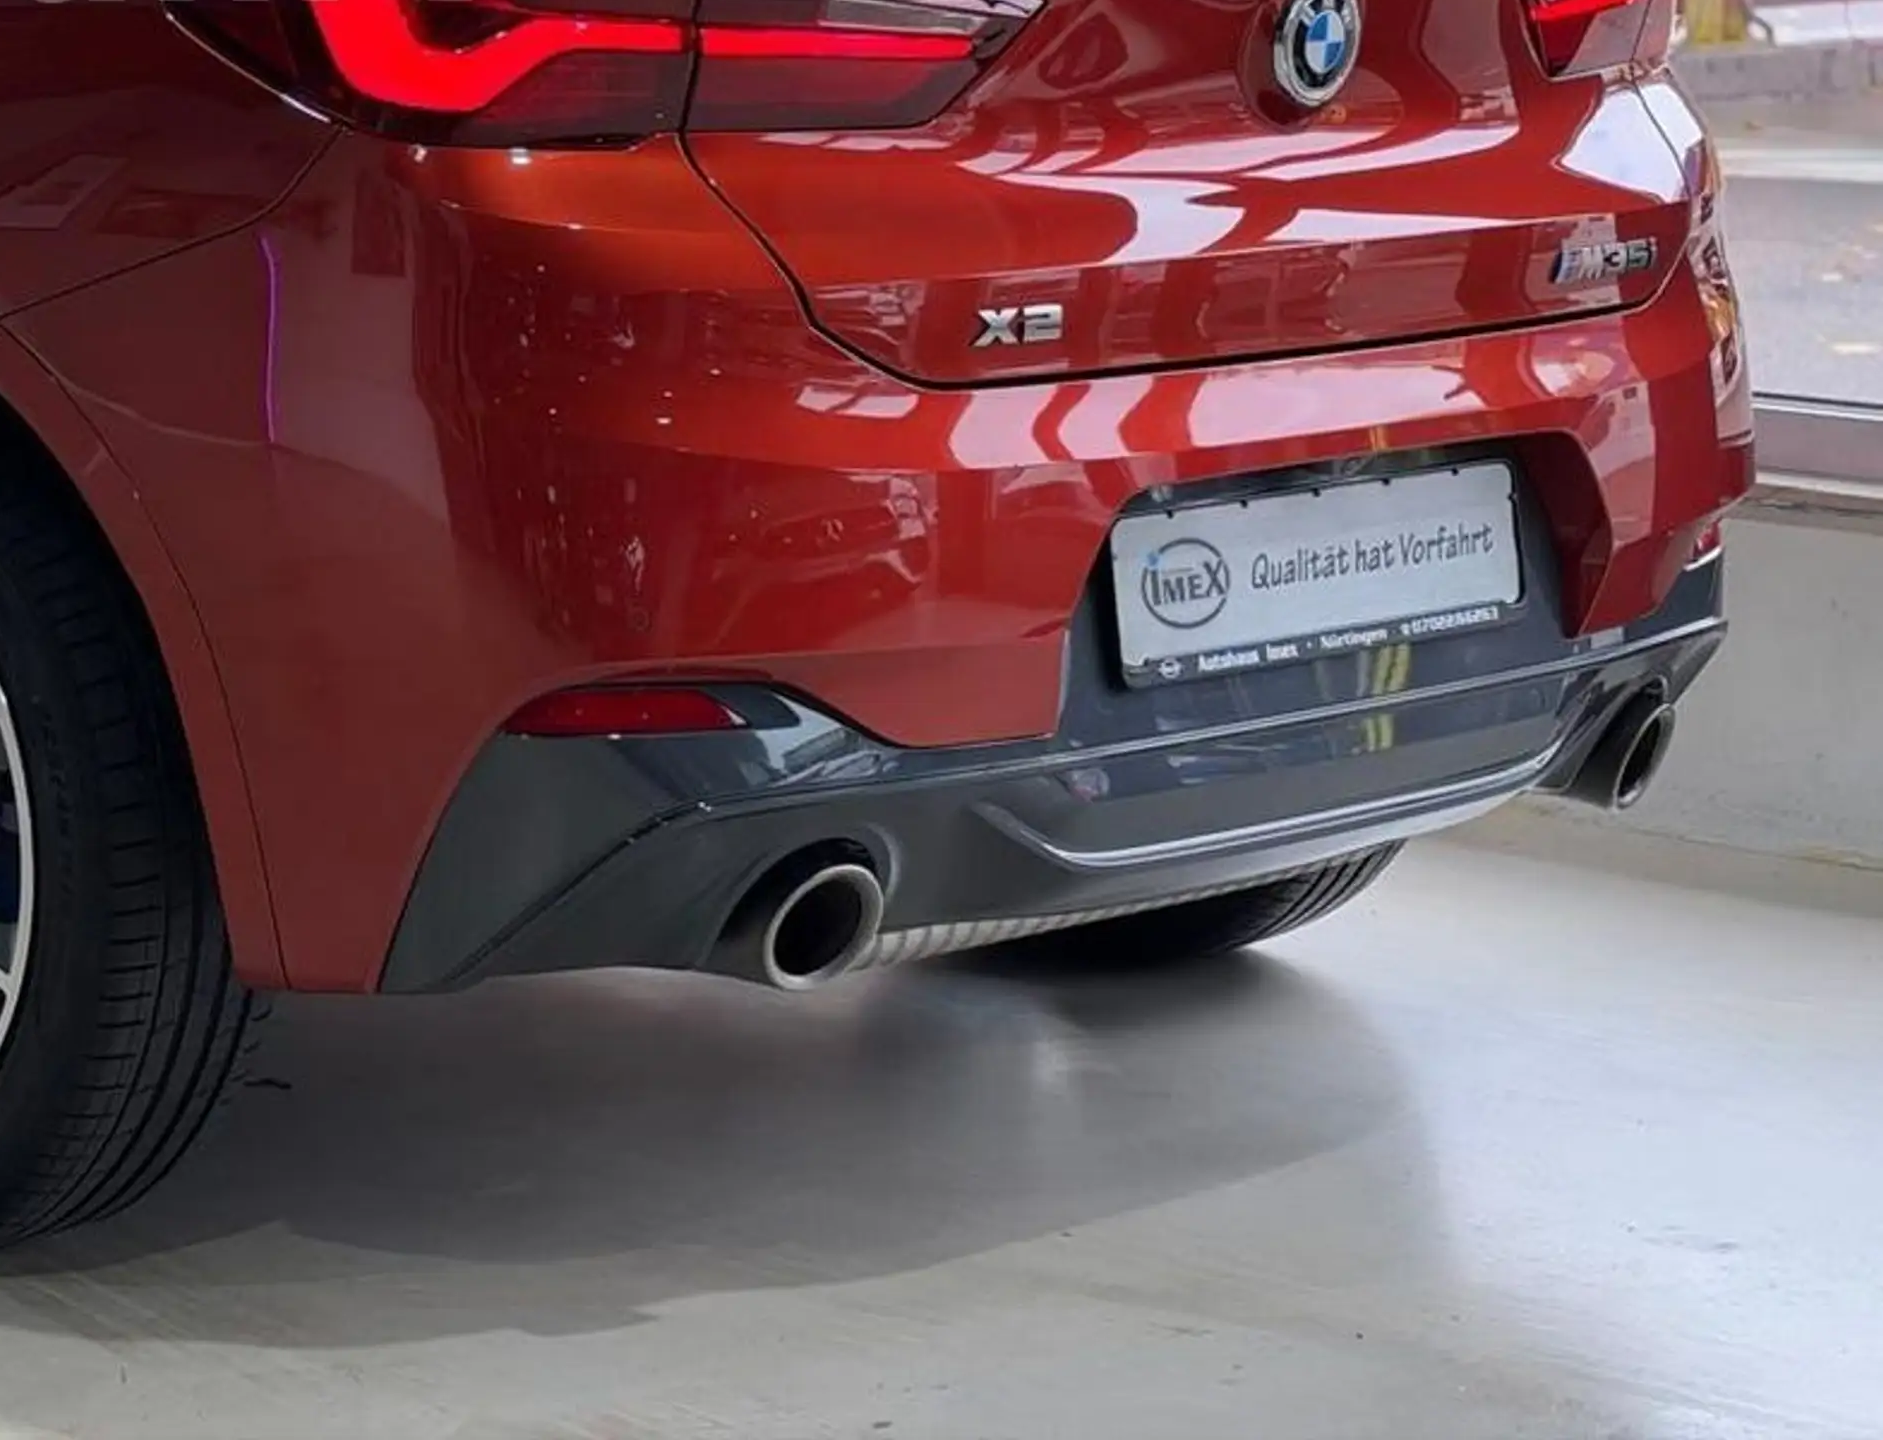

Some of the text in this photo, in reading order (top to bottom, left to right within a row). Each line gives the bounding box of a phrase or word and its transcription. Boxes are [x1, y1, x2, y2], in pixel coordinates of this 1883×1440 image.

[970, 302, 1065, 348] X2
[1250, 522, 1495, 592] Qualität hat Vorfahrt
